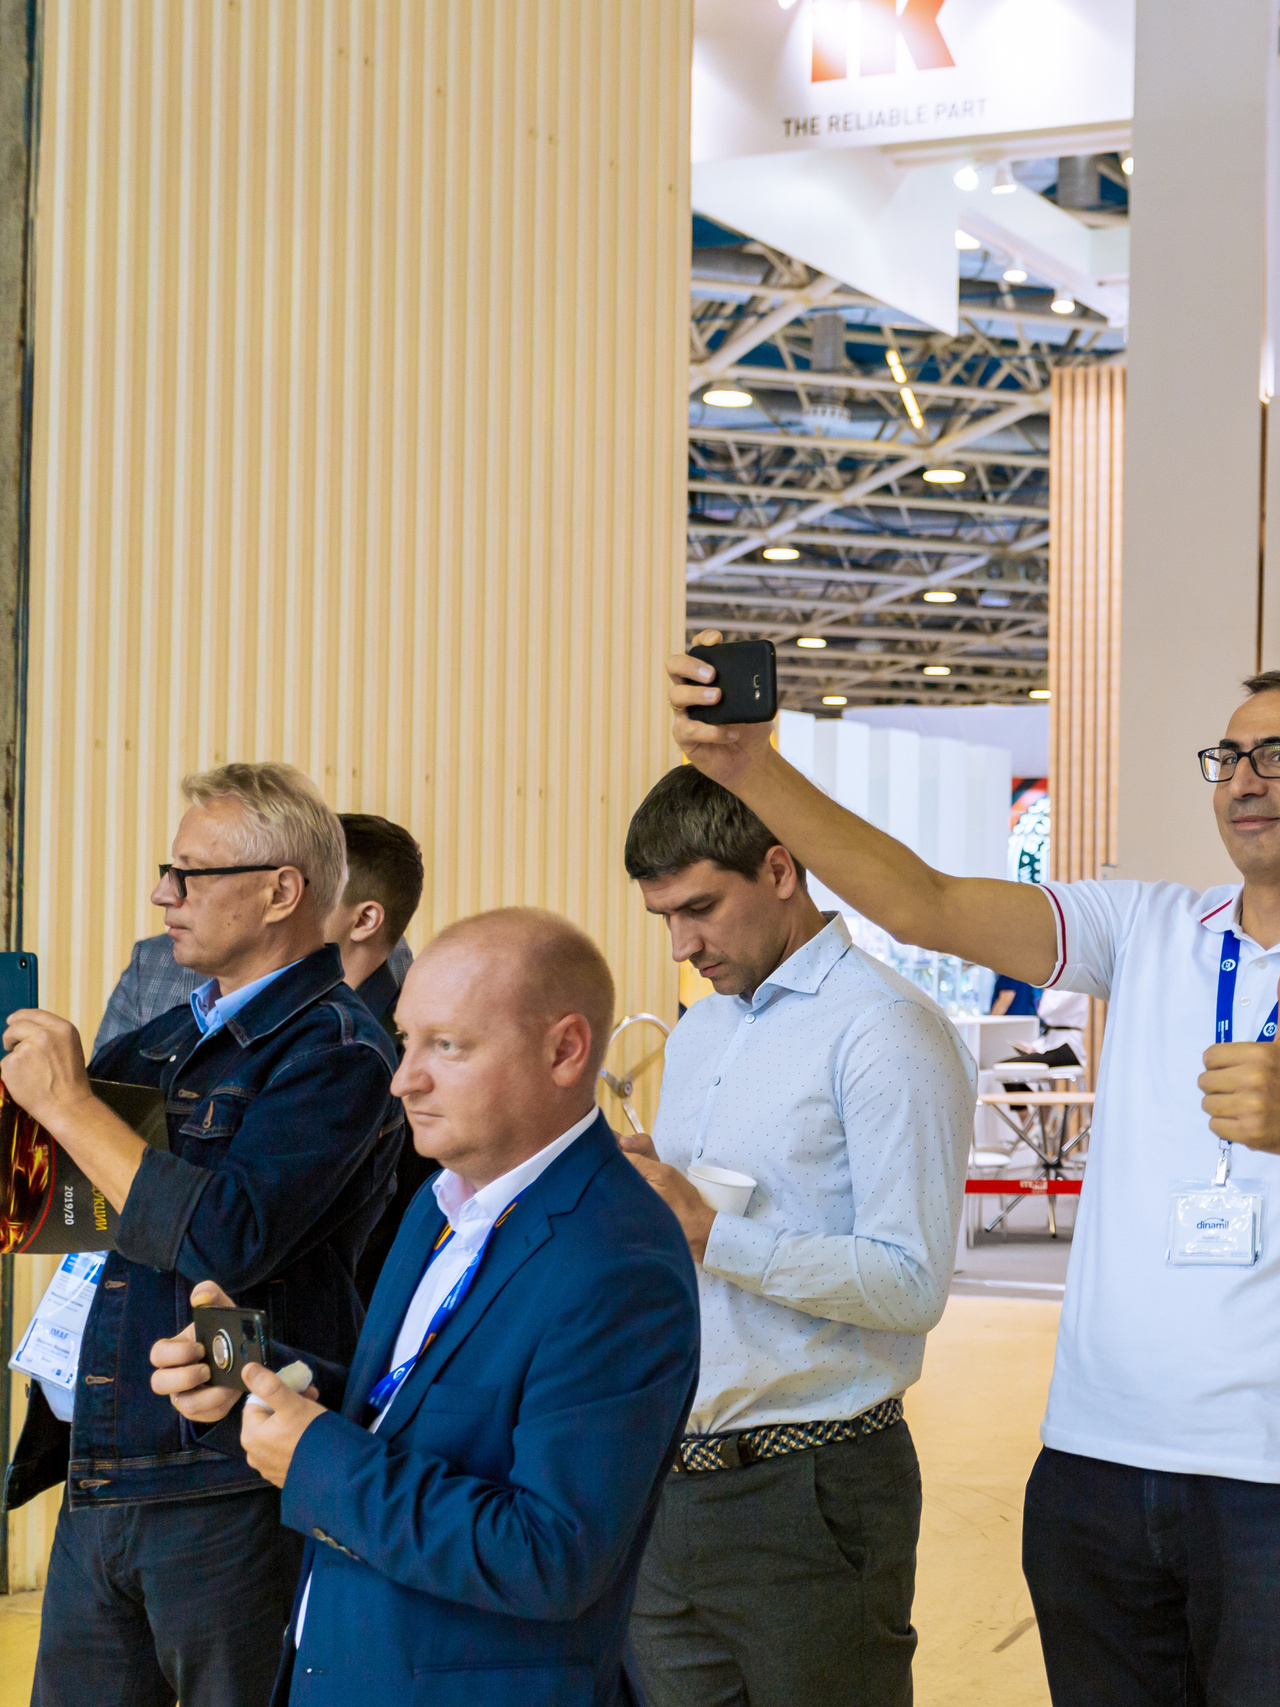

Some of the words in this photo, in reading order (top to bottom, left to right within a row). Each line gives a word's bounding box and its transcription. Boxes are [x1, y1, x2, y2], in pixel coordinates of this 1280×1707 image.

[783, 116, 821, 137] THE
[828, 106, 927, 133] RELIABLE
[935, 98, 987, 120] PART
[63, 1185, 74, 1226] 2019/20
